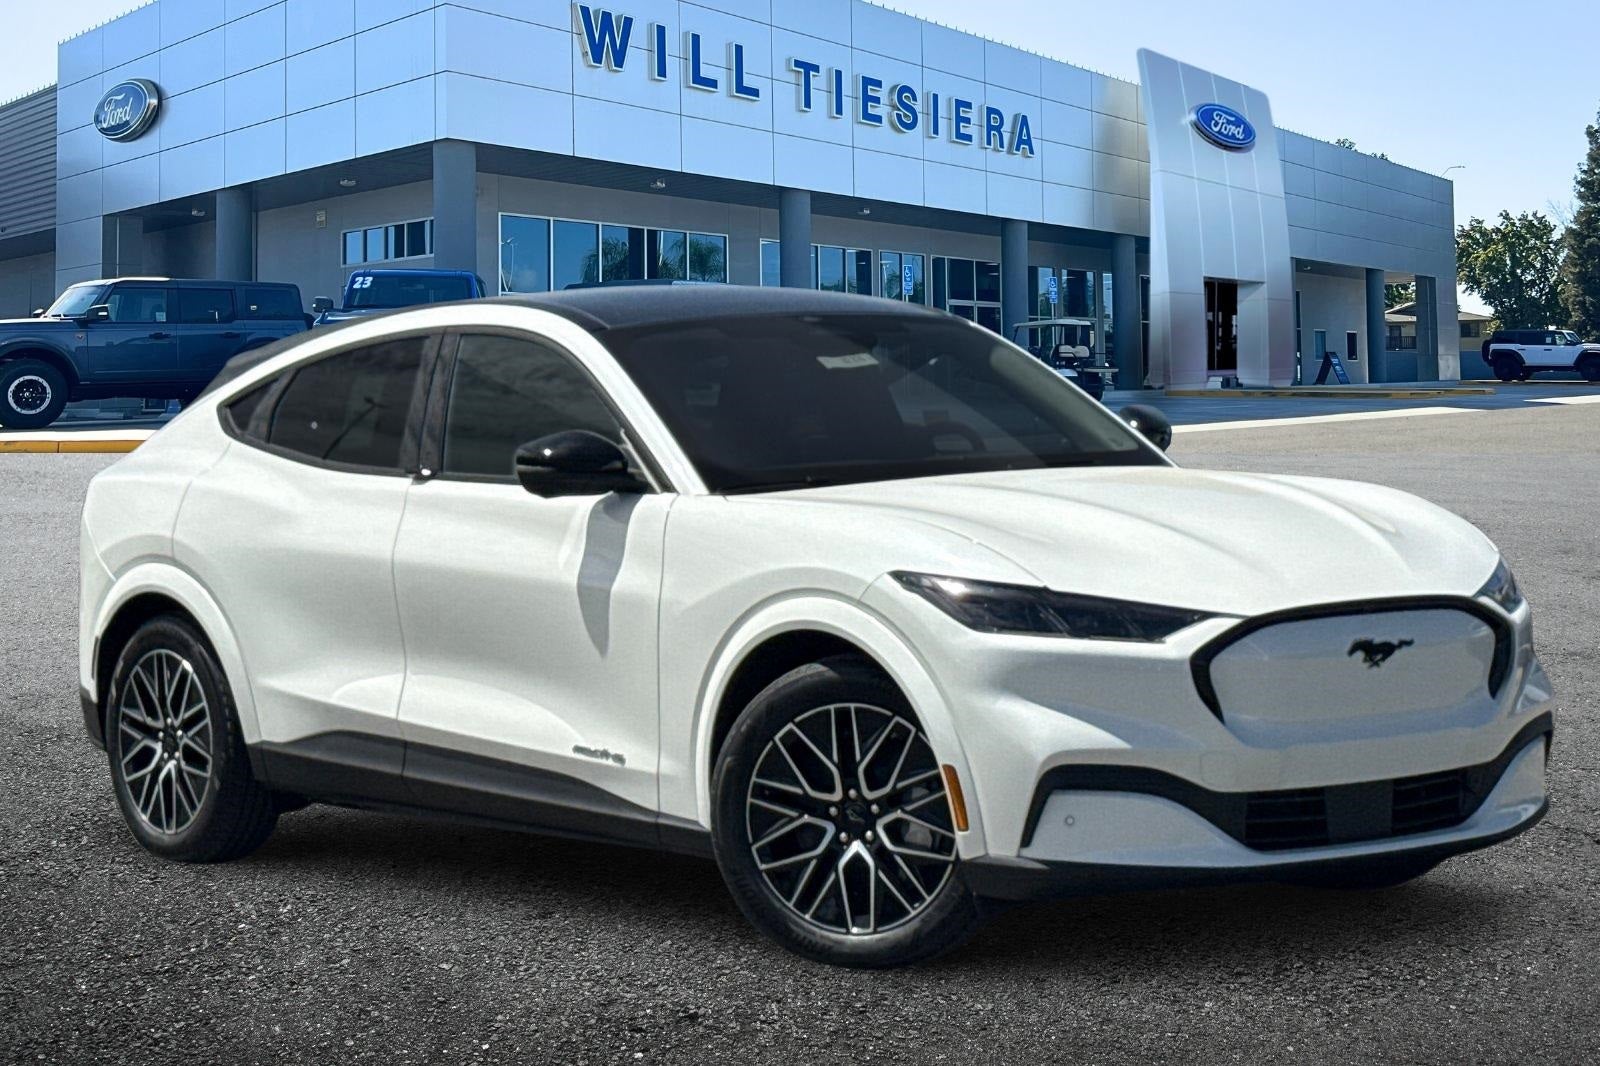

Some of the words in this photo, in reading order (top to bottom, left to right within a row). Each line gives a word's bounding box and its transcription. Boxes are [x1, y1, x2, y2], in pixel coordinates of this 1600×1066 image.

[574, 2, 760, 100] WILL
[789, 57, 1036, 157] TIESIERA
[101, 93, 134, 129] Ford
[1211, 110, 1245, 140] Ford
[353, 276, 373, 289] 23
